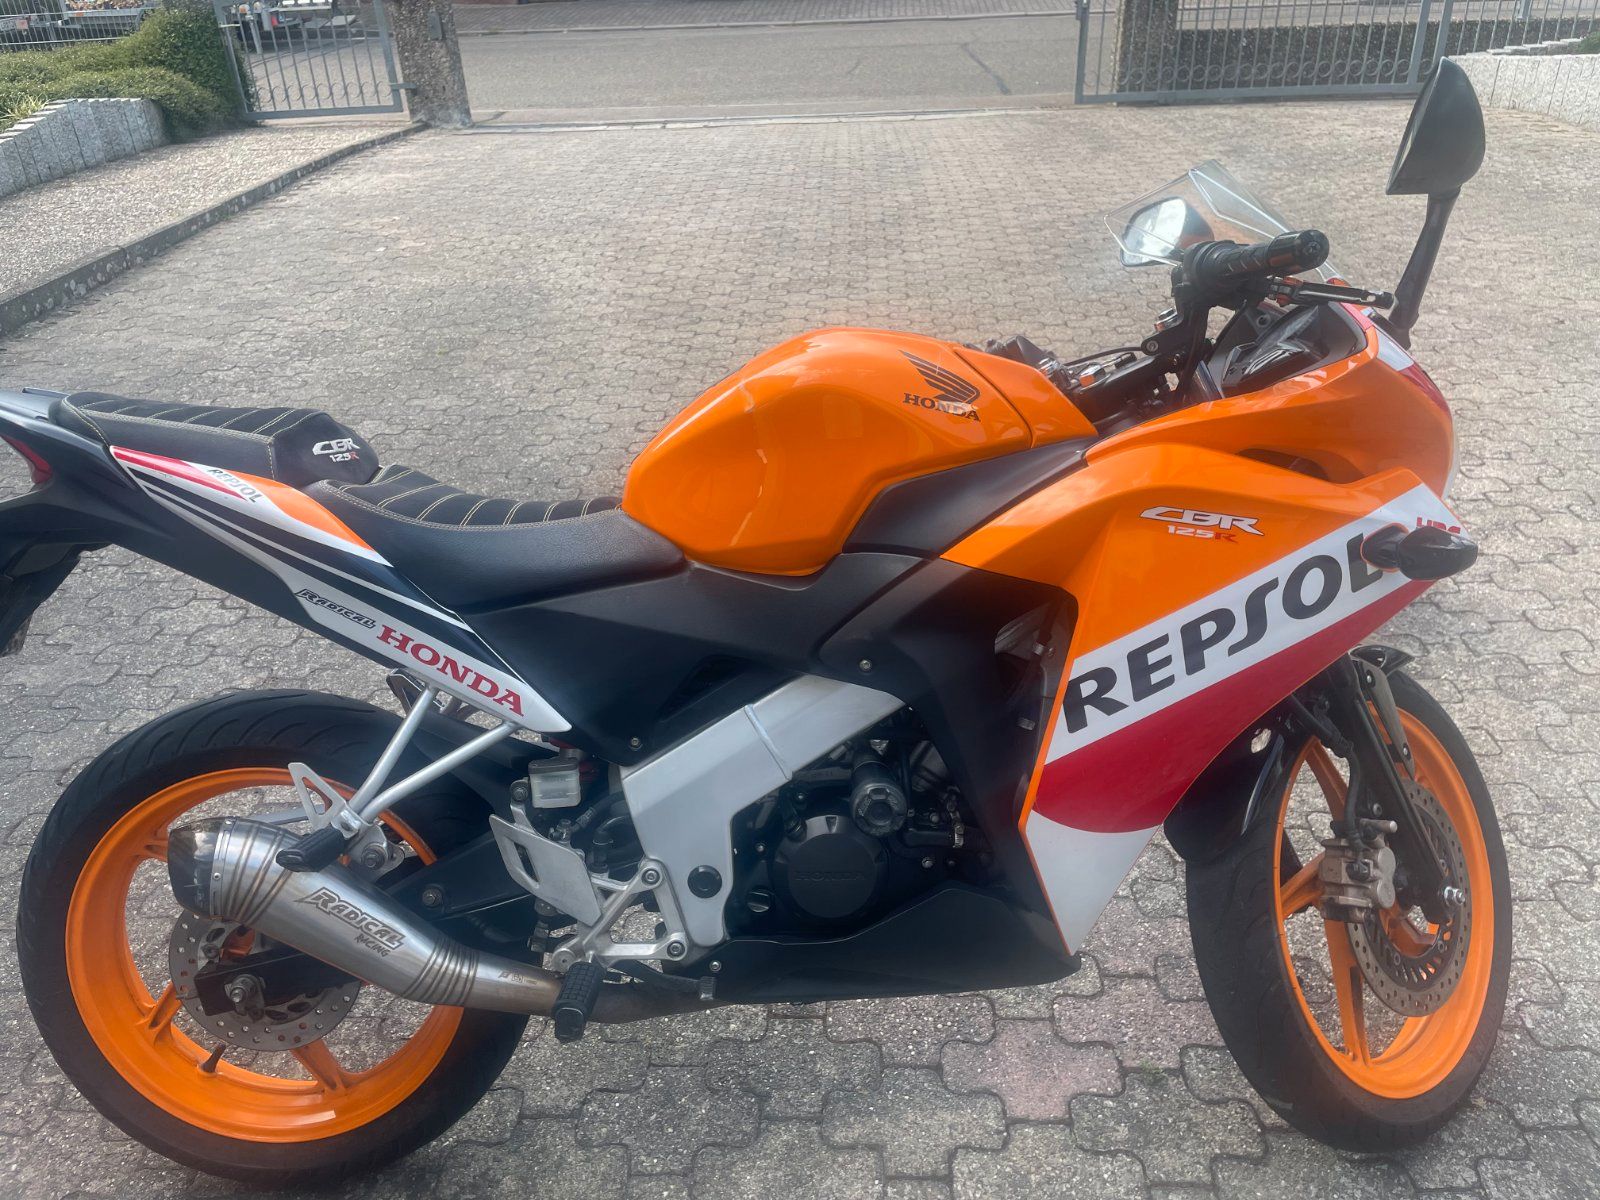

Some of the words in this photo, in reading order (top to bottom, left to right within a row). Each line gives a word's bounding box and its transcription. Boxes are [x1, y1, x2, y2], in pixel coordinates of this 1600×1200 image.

[902, 392, 981, 422] HONDA
[312, 437, 361, 456] CBR
[329, 451, 360, 462] 125R
[207, 469, 263, 503] REPSOL
[1139, 505, 1264, 536] CBR
[1167, 524, 1239, 544] 125R
[295, 588, 376, 628] RADICAL
[1063, 533, 1383, 734] REPSOL
[376, 624, 525, 717] HONDA
[296, 886, 405, 950] RADICAL
